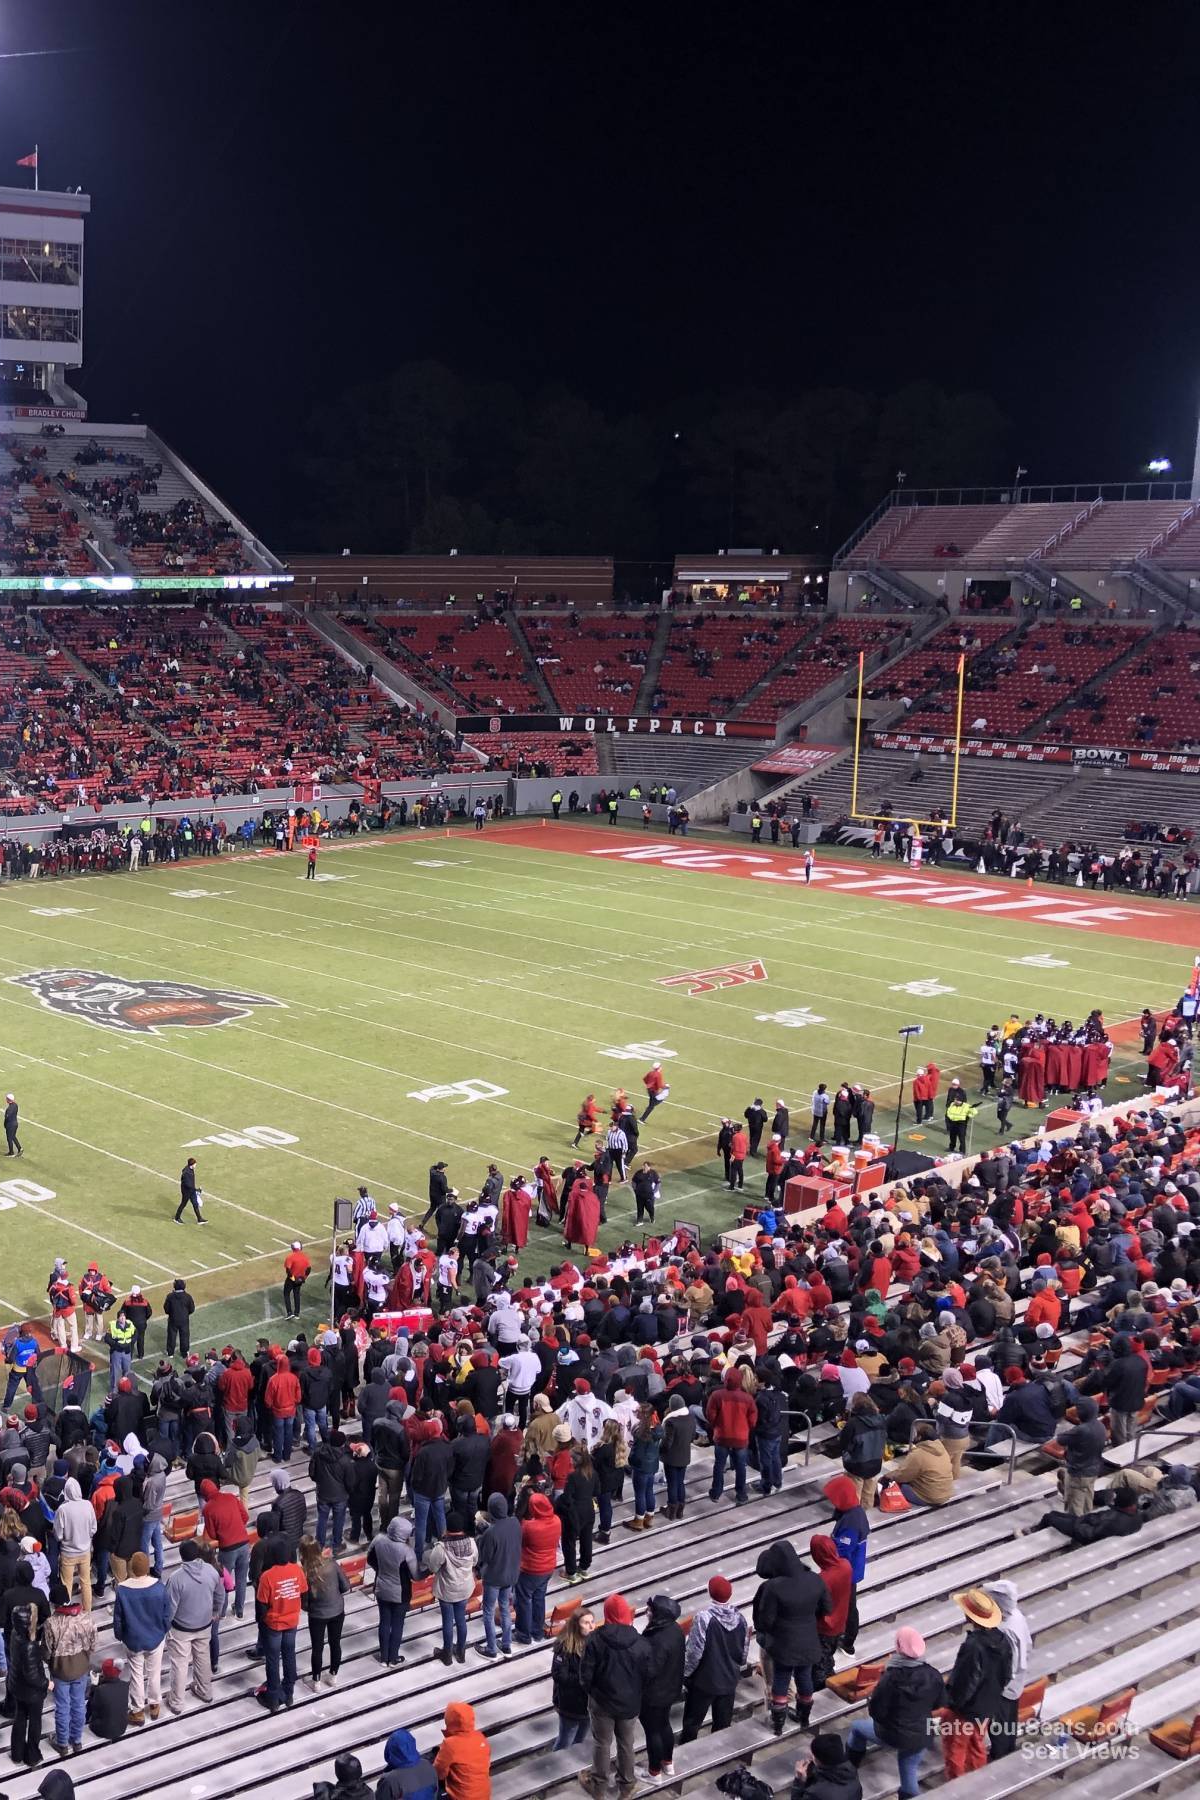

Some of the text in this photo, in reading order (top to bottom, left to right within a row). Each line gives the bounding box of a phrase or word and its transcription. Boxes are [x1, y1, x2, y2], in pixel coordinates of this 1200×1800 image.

[28, 408, 87, 418] BRADLEY CHUBB
[951, 746, 970, 755] 208
[967, 740, 982, 748] 1973
[992, 742, 1007, 750] 1974
[1017, 744, 1033, 752] 1975
[1043, 746, 1059, 754] 1977
[1074, 749, 1126, 763] BOWL
[1152, 762, 1200, 772] 2014 2015
[589, 843, 1175, 926] NC STATE
[207, 1125, 300, 1150] 40
